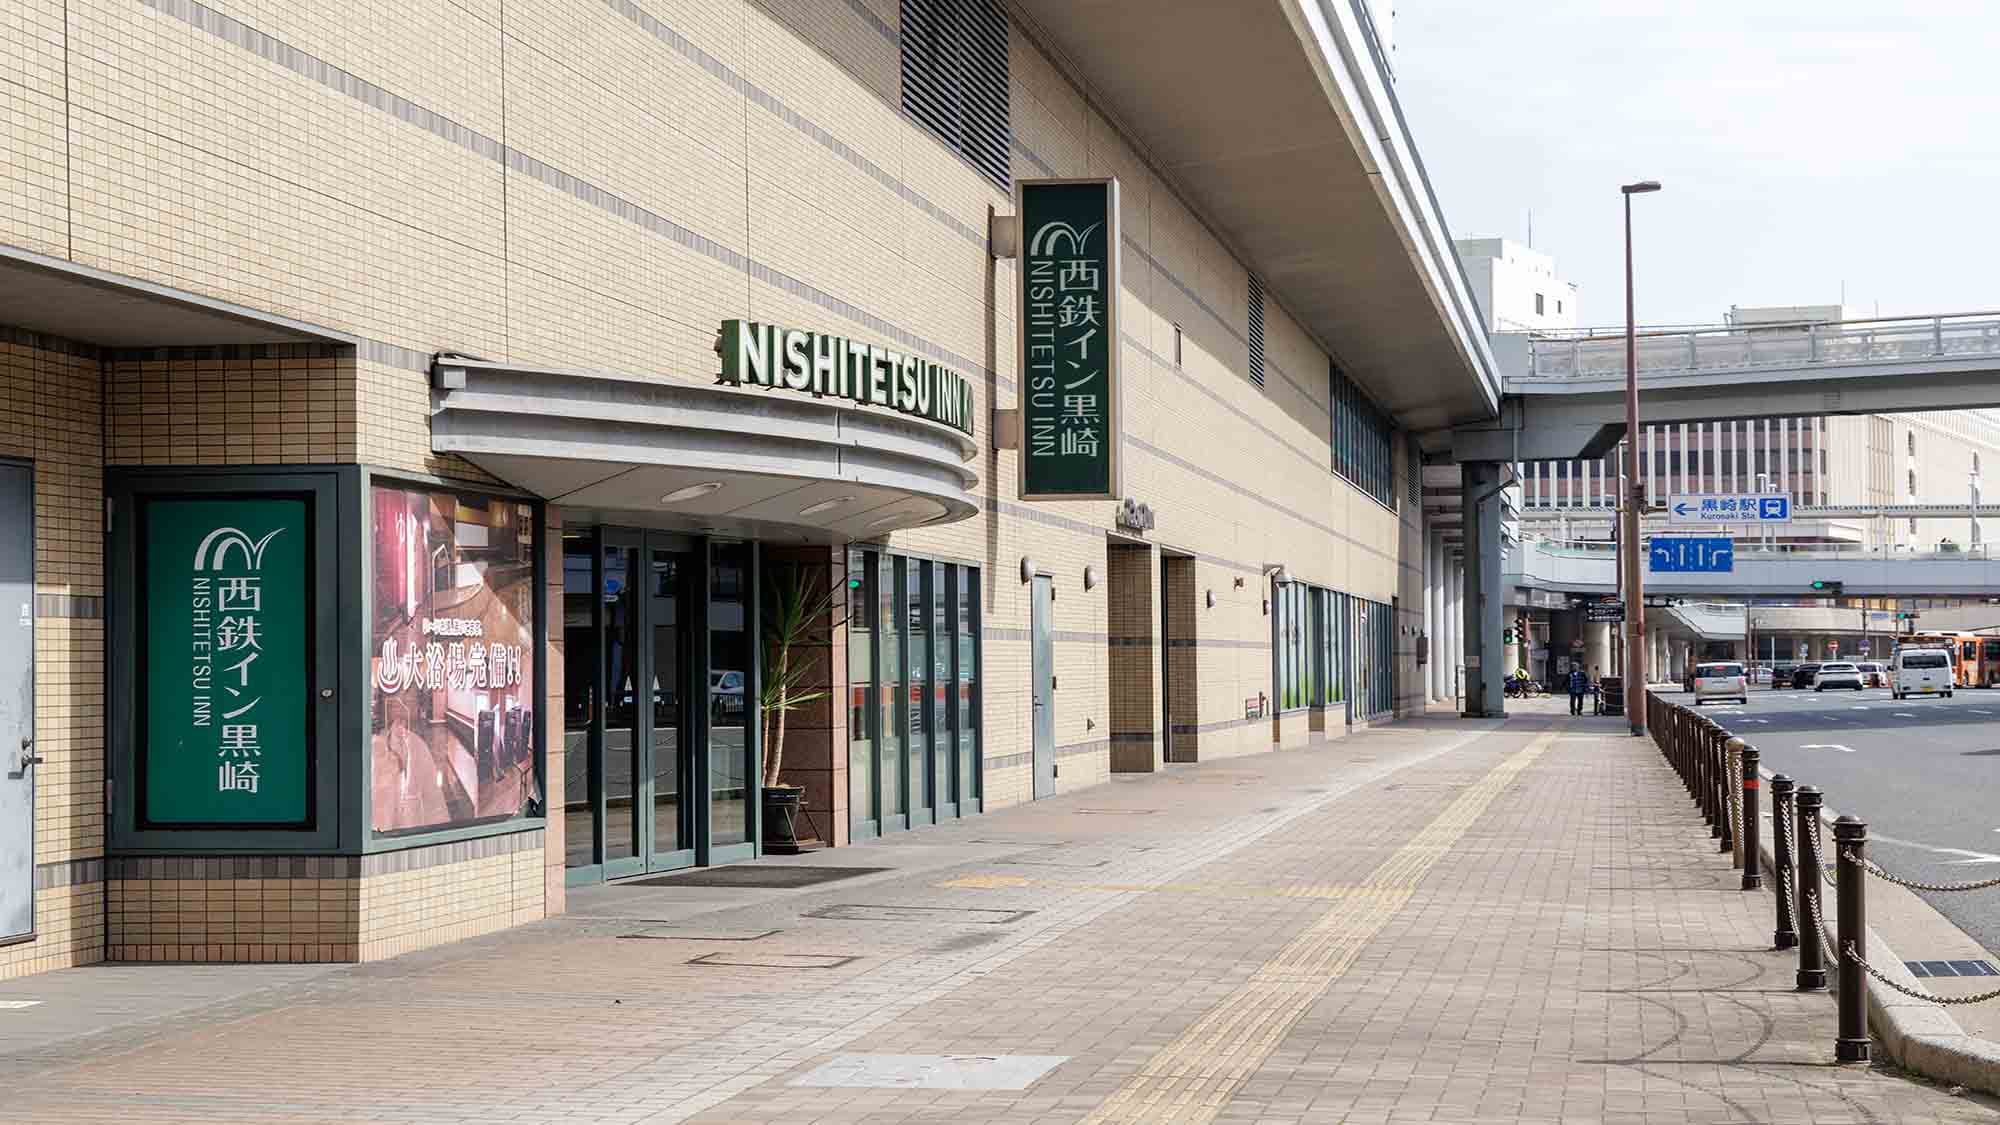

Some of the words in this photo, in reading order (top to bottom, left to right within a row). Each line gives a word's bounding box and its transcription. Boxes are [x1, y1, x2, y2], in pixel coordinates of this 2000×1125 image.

[736, 319, 930, 416] NISHITETSU
[936, 366, 961, 427] INN
[1031, 261, 1055, 408] NISHITETSU
[1058, 259, 1101, 457] 西鉄イン黒崎
[1031, 416, 1055, 456] INN
[1701, 498, 1757, 511] 黒崎駅
[193, 577, 211, 689] NISHITETSU
[217, 577, 263, 793] 西鉄イン黒崎
[193, 695, 211, 726] INN
